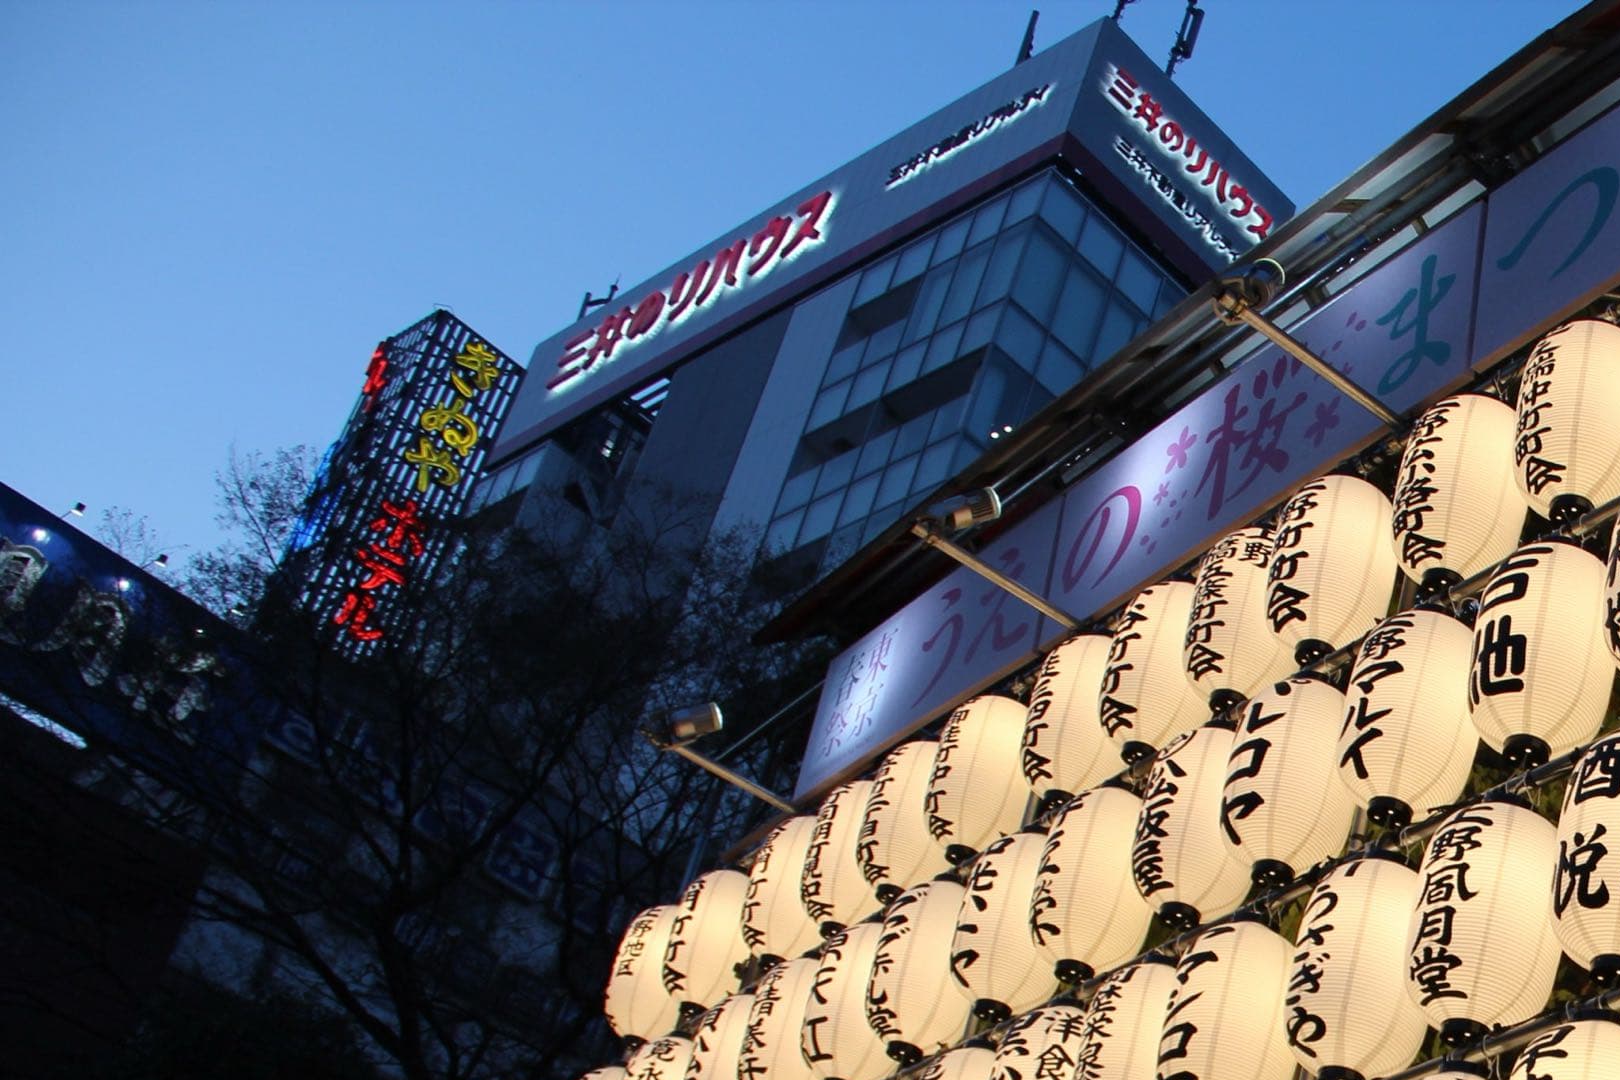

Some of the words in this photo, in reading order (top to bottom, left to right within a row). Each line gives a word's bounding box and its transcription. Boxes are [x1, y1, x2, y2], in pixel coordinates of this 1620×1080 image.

[1106, 66, 1274, 241] 三井のリハウス
[546, 191, 833, 391] 三井のリハウス
[333, 501, 424, 641] ホテル
[1284, 884, 1344, 1058] うさぎや
